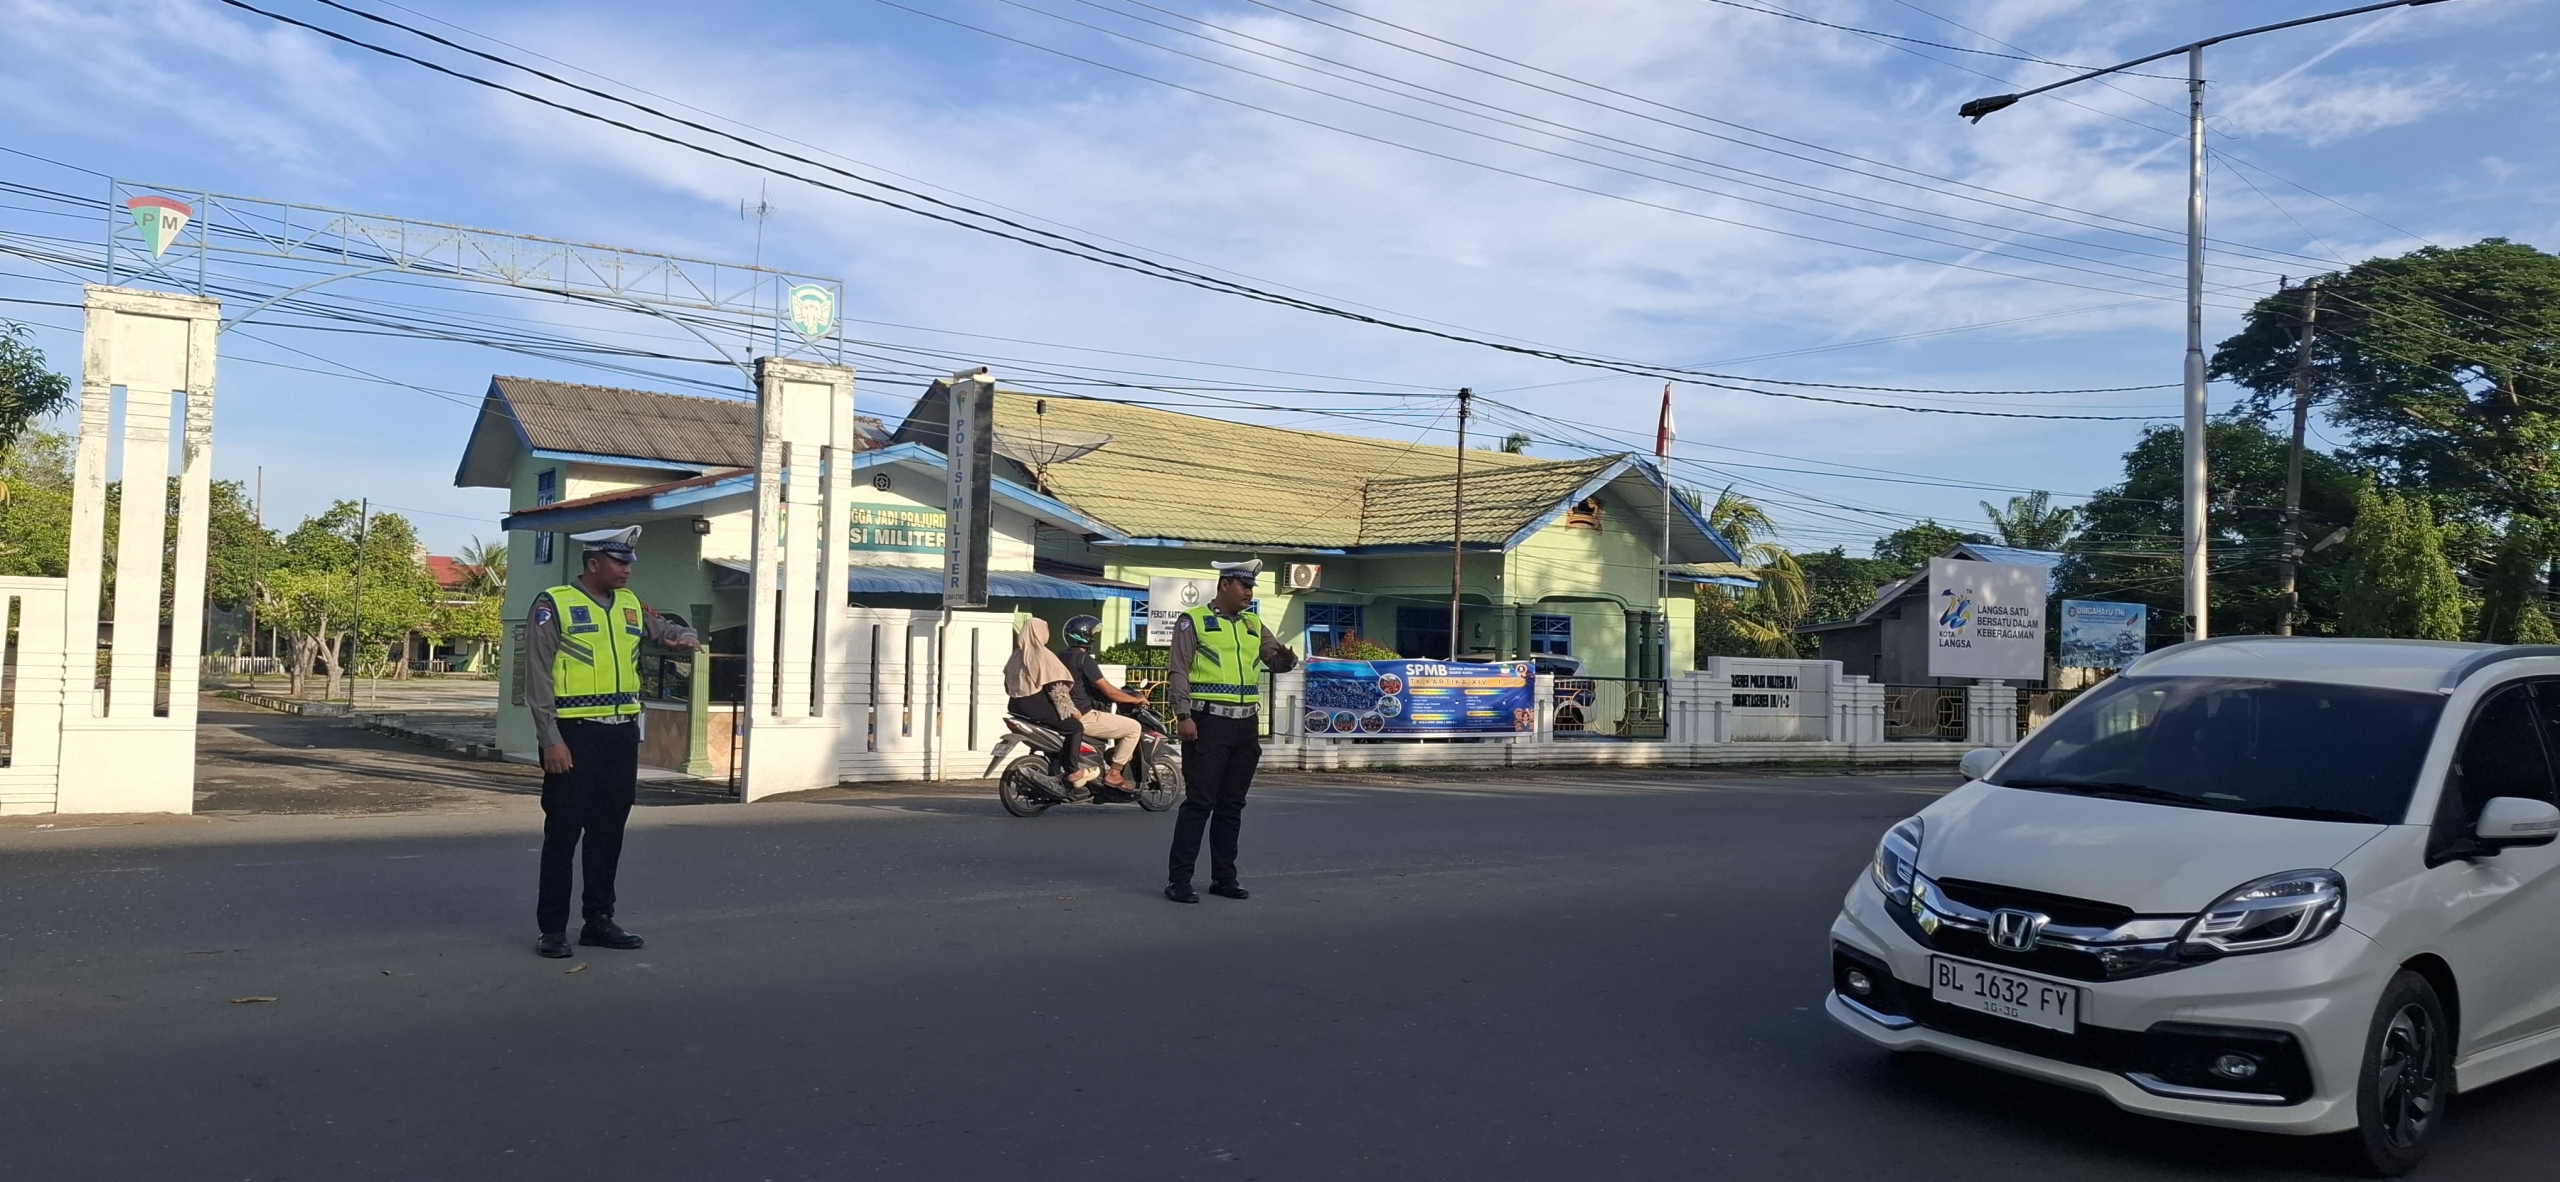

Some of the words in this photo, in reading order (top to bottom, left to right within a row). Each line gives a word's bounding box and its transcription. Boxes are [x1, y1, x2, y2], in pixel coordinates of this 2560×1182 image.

[142, 212, 155, 227] P
[162, 215, 178, 230] M
[954, 419, 965, 497] POLISI
[851, 509, 873, 525] GGA
[875, 510, 898, 526] JADI
[874, 528, 946, 548] MILITER
[950, 497, 963, 589] MILITER
[1151, 610, 1167, 619] PERSIT
[1977, 605, 2008, 616] LANGSA
[2010, 607, 2029, 617] SATU
[2077, 606, 2113, 615] DIRGAHAYU
[1977, 616, 2012, 627] BERSATU
[2013, 619, 2039, 629] DALAM
[1939, 630, 1955, 638] KOTA
[1977, 628, 2034, 639] KEBERAGAMAN
[1939, 638, 1972, 648] LANGSA
[1405, 663, 1448, 676] SPMB
[1939, 963, 1964, 991] BL
[1974, 972, 2029, 1007] 1632
[2040, 987, 2068, 1016] FY
